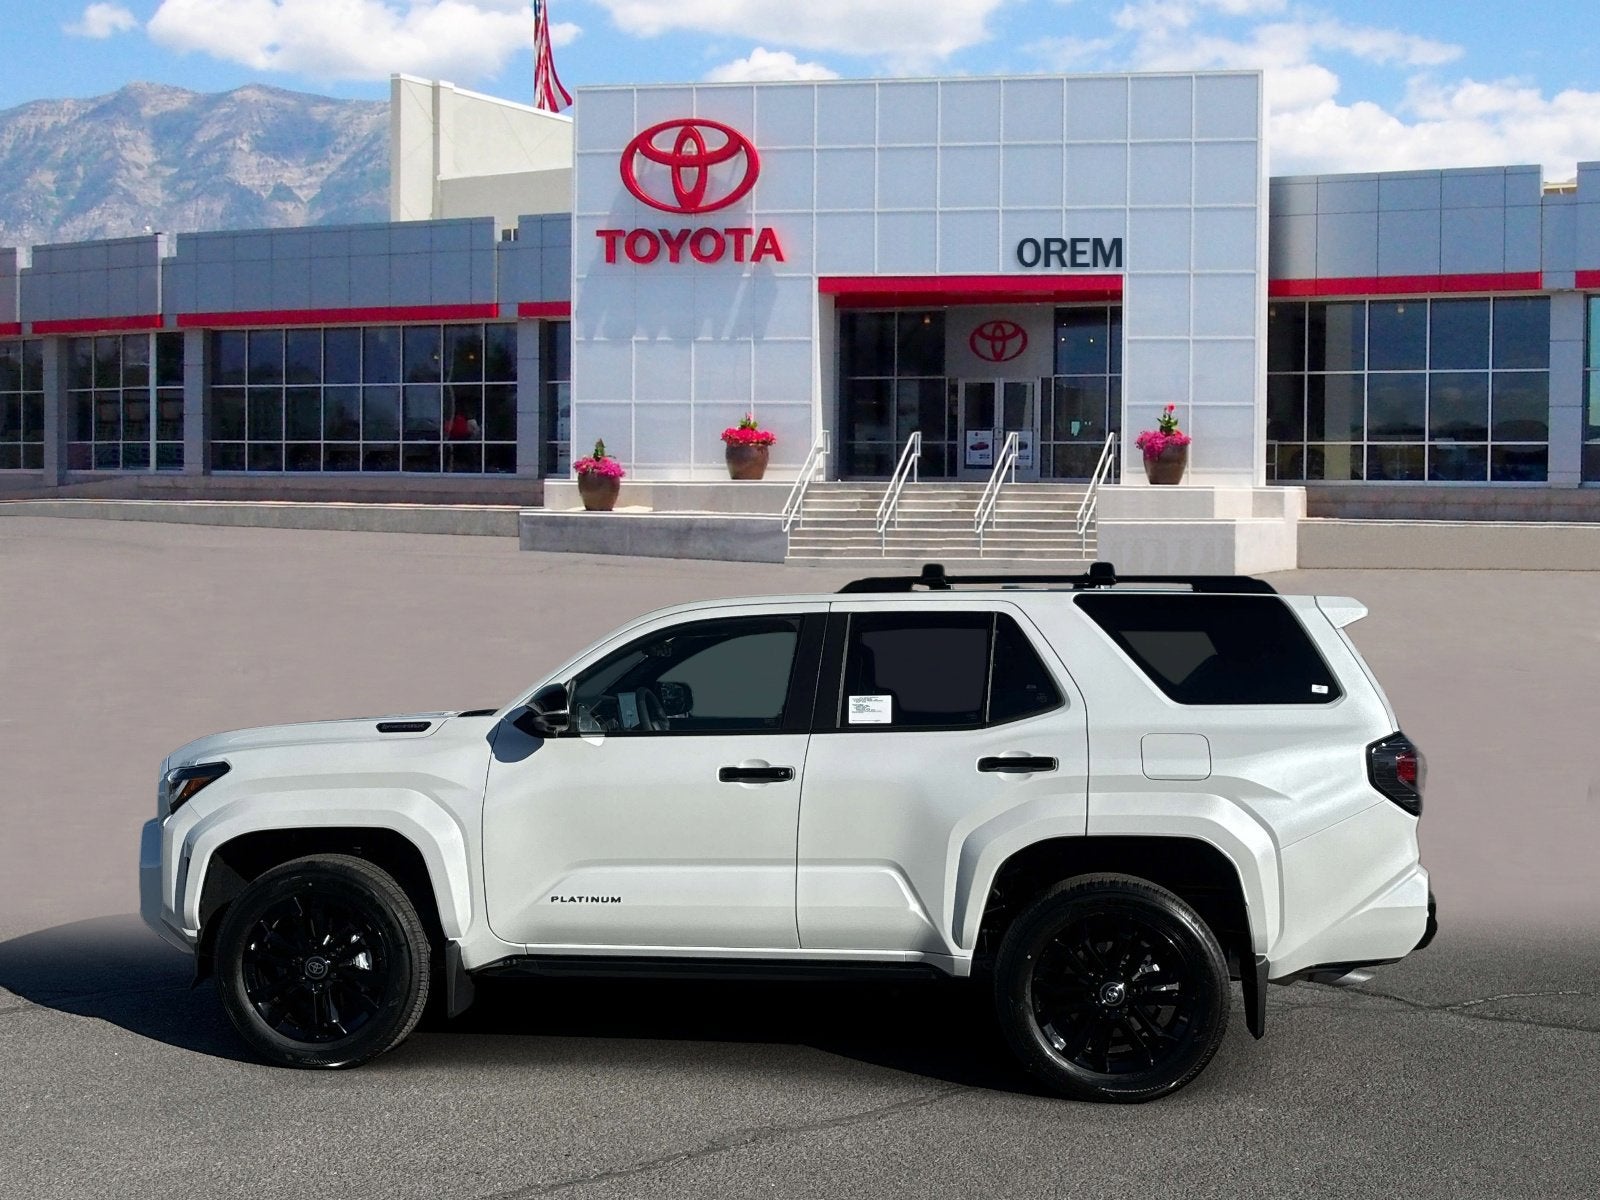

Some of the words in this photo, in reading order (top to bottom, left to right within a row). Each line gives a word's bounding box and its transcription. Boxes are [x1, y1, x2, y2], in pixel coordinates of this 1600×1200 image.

[596, 227, 785, 264] TOYOTA
[1017, 237, 1122, 268] OREM
[550, 895, 622, 903] PLATINUM
